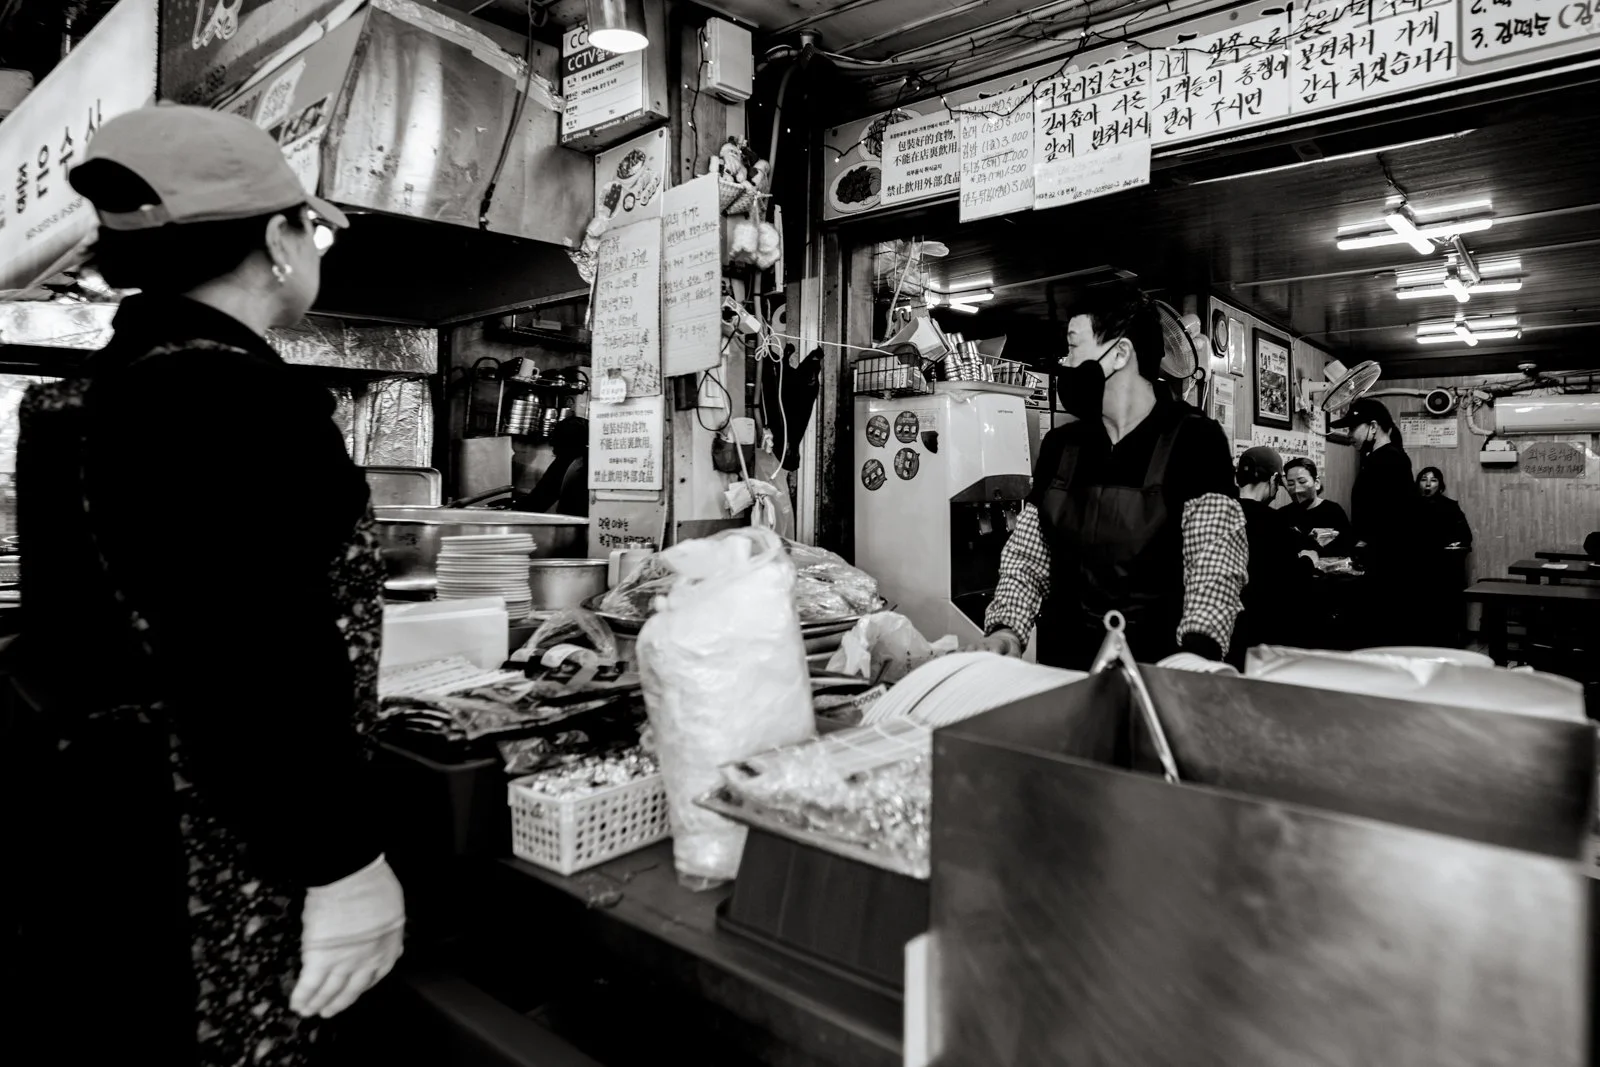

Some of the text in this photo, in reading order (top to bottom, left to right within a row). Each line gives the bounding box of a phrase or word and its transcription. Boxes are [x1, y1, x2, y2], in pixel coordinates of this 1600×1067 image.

[1471, 28, 1488, 48] 3.
[1558, 0, 1600, 29] (김
[1039, 71, 1103, 109] 떡볶이집
[1105, 61, 1150, 88] 손님은
[1157, 50, 1187, 78] 가게
[1112, 91, 1147, 115] 다른
[1152, 70, 1222, 111] 고객들의
[1235, 54, 1289, 85] 통행이
[1296, 29, 1375, 71] 불편하니
[1395, 11, 1439, 46] 가게
[1044, 133, 1075, 163] 앞에
[1163, 107, 1197, 135] 말아
[1205, 88, 1262, 126] 주시면
